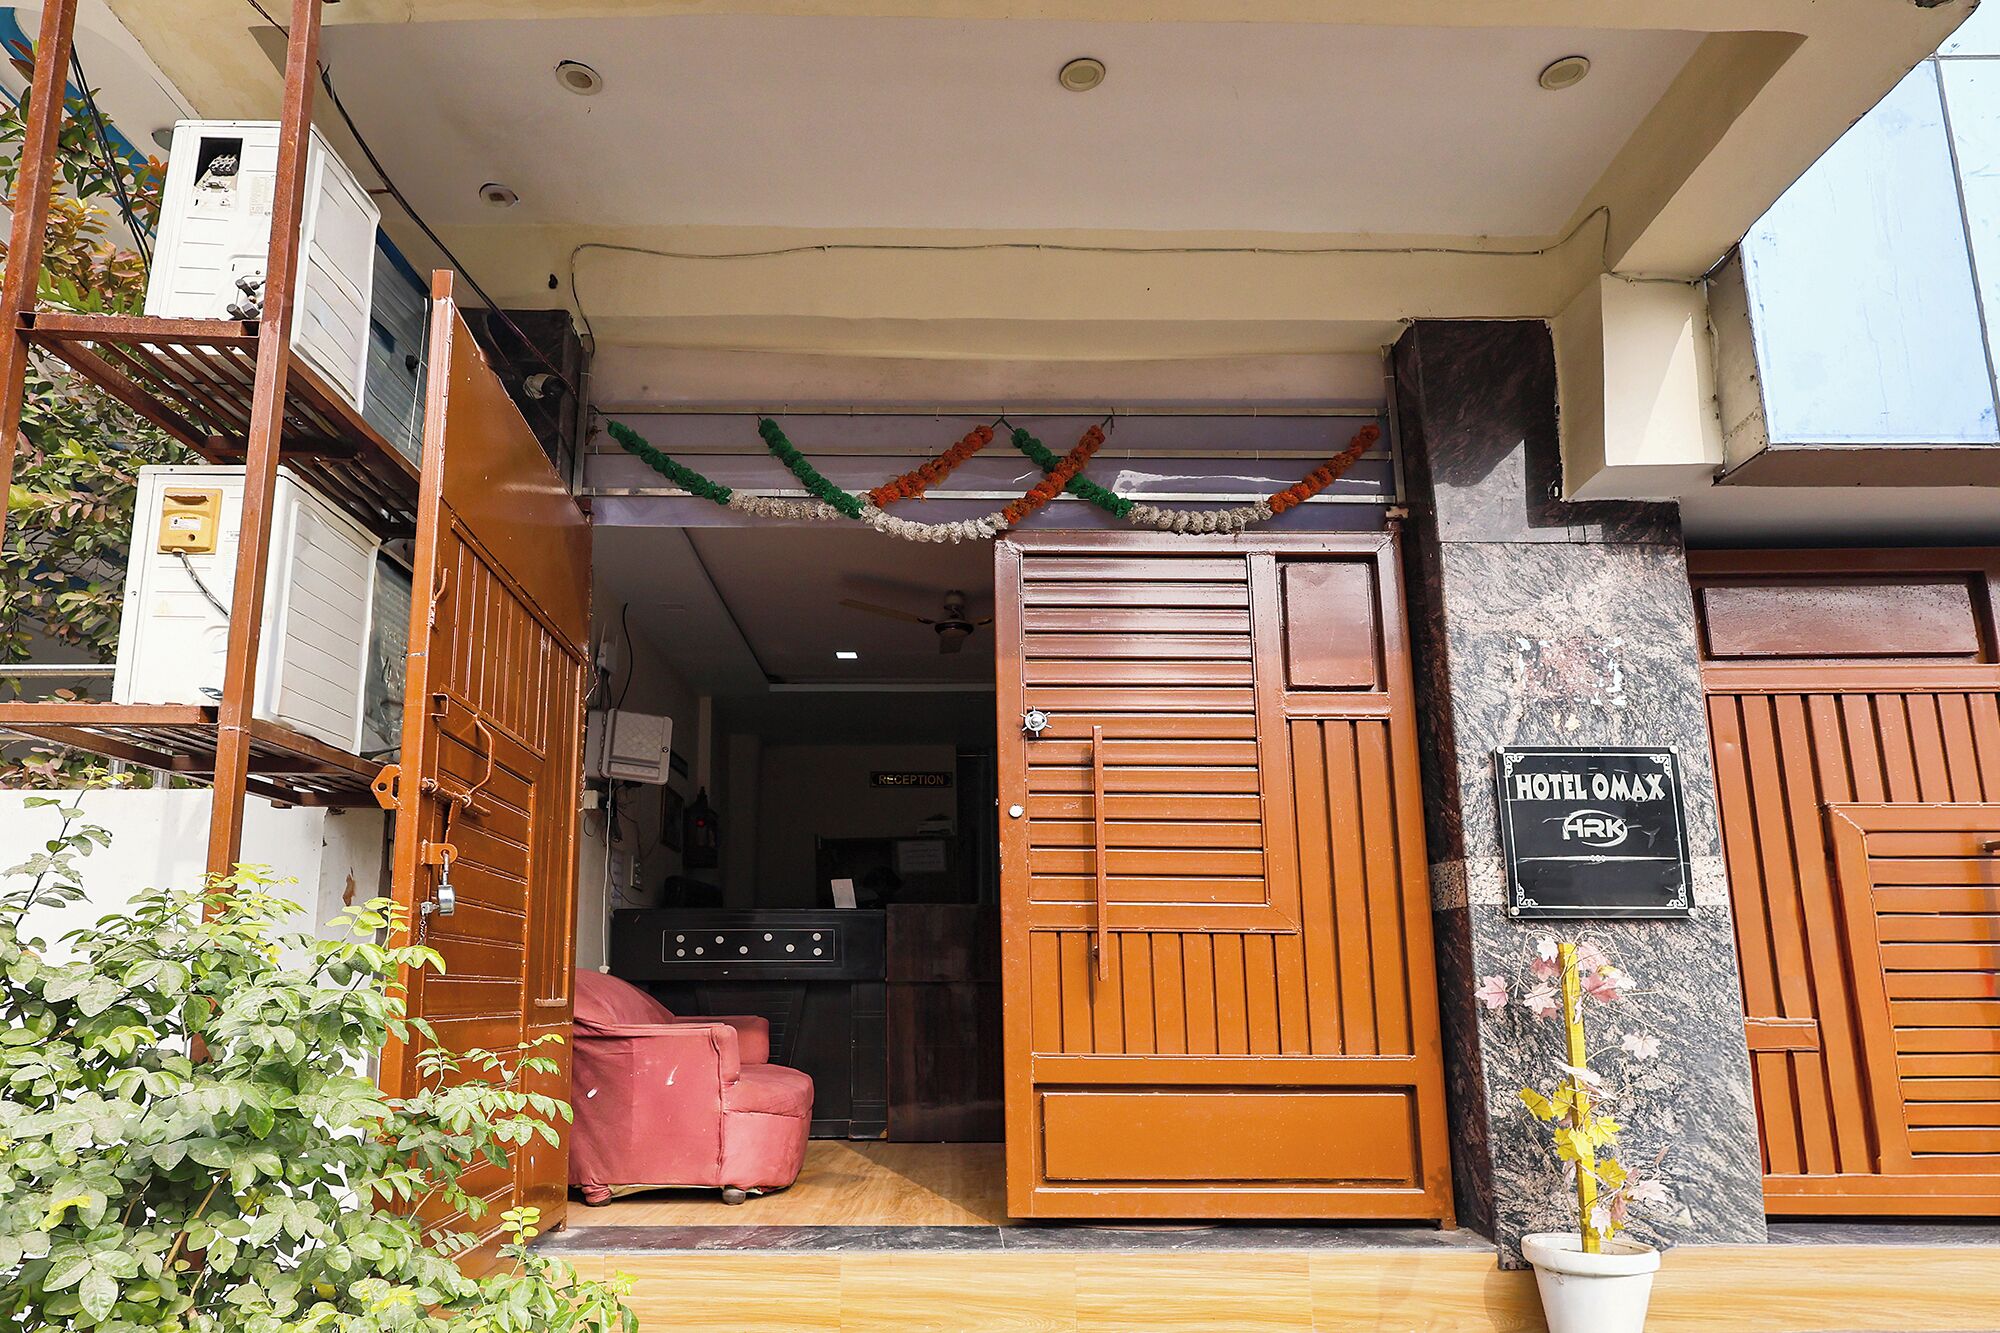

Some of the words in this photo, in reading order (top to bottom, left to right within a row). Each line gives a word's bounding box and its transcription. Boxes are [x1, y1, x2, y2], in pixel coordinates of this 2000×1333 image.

[878, 774, 945, 785] RECEPTION
[1515, 773, 1588, 801] HOTEL
[1591, 772, 1666, 802] OMAX
